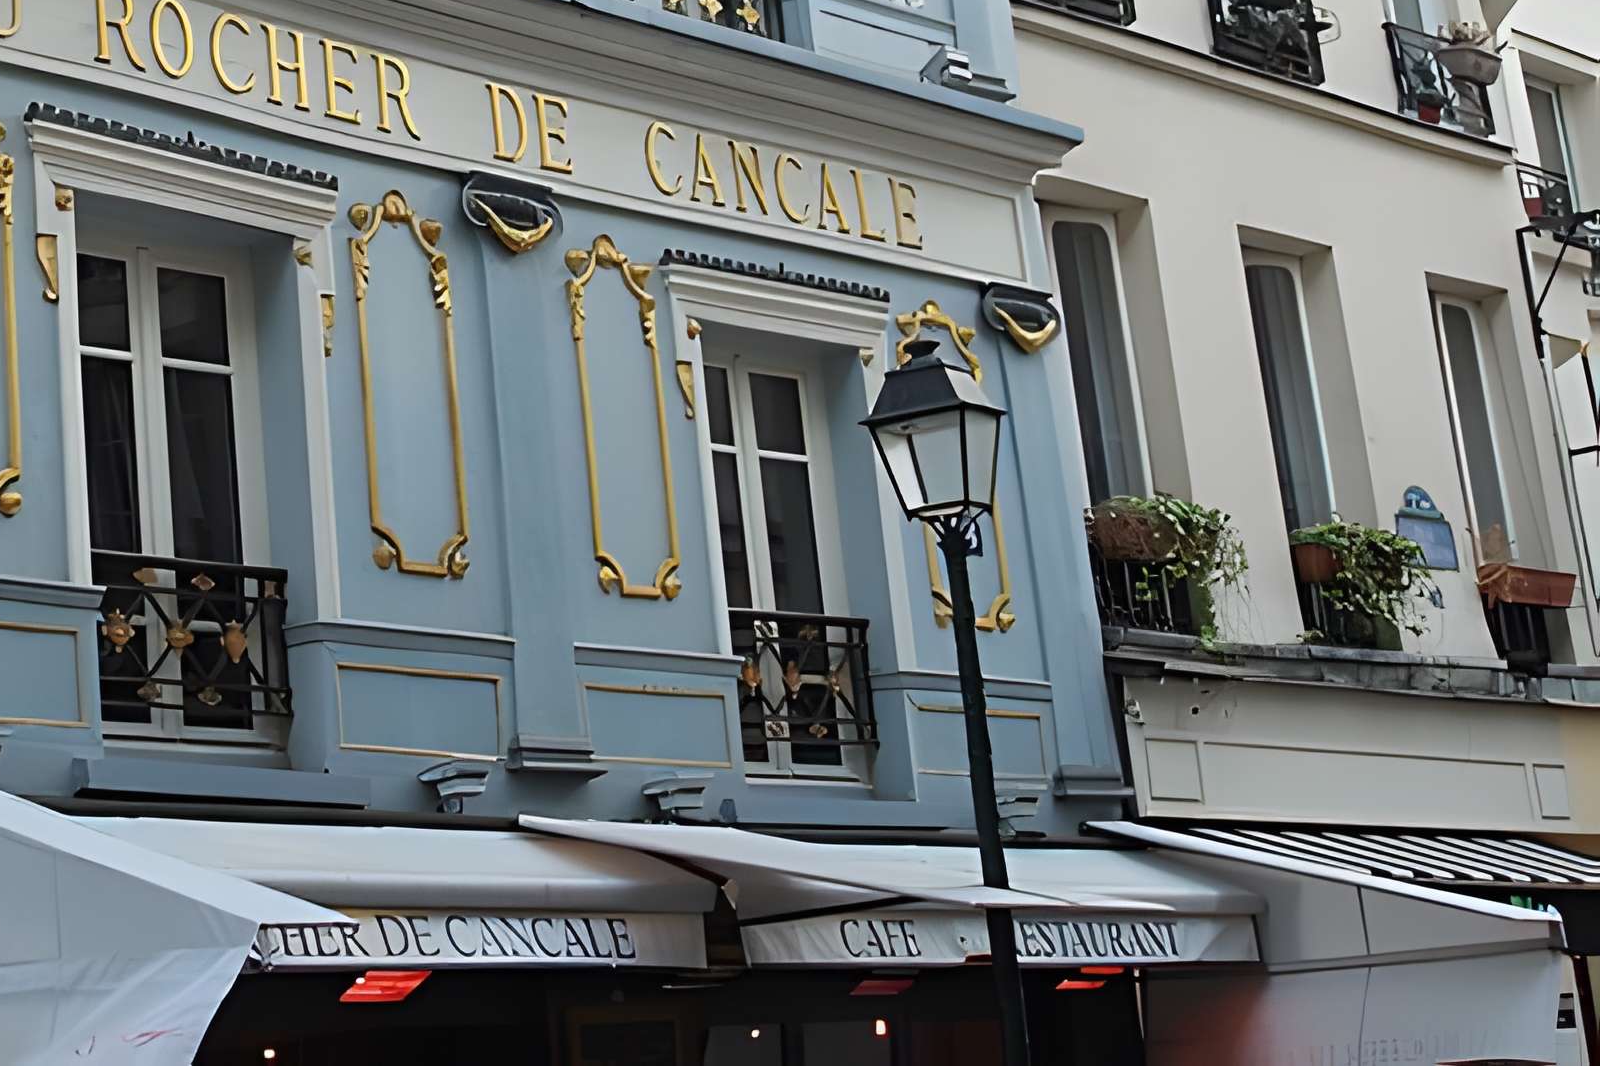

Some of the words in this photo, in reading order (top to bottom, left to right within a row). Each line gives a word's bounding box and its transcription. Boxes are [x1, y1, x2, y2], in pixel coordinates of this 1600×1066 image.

[485, 82, 573, 174] DE
[644, 120, 923, 250] CANCALE
[375, 915, 441, 956] DE
[445, 914, 637, 959] CANCALE
[1014, 920, 1181, 959] ESTAURANT
